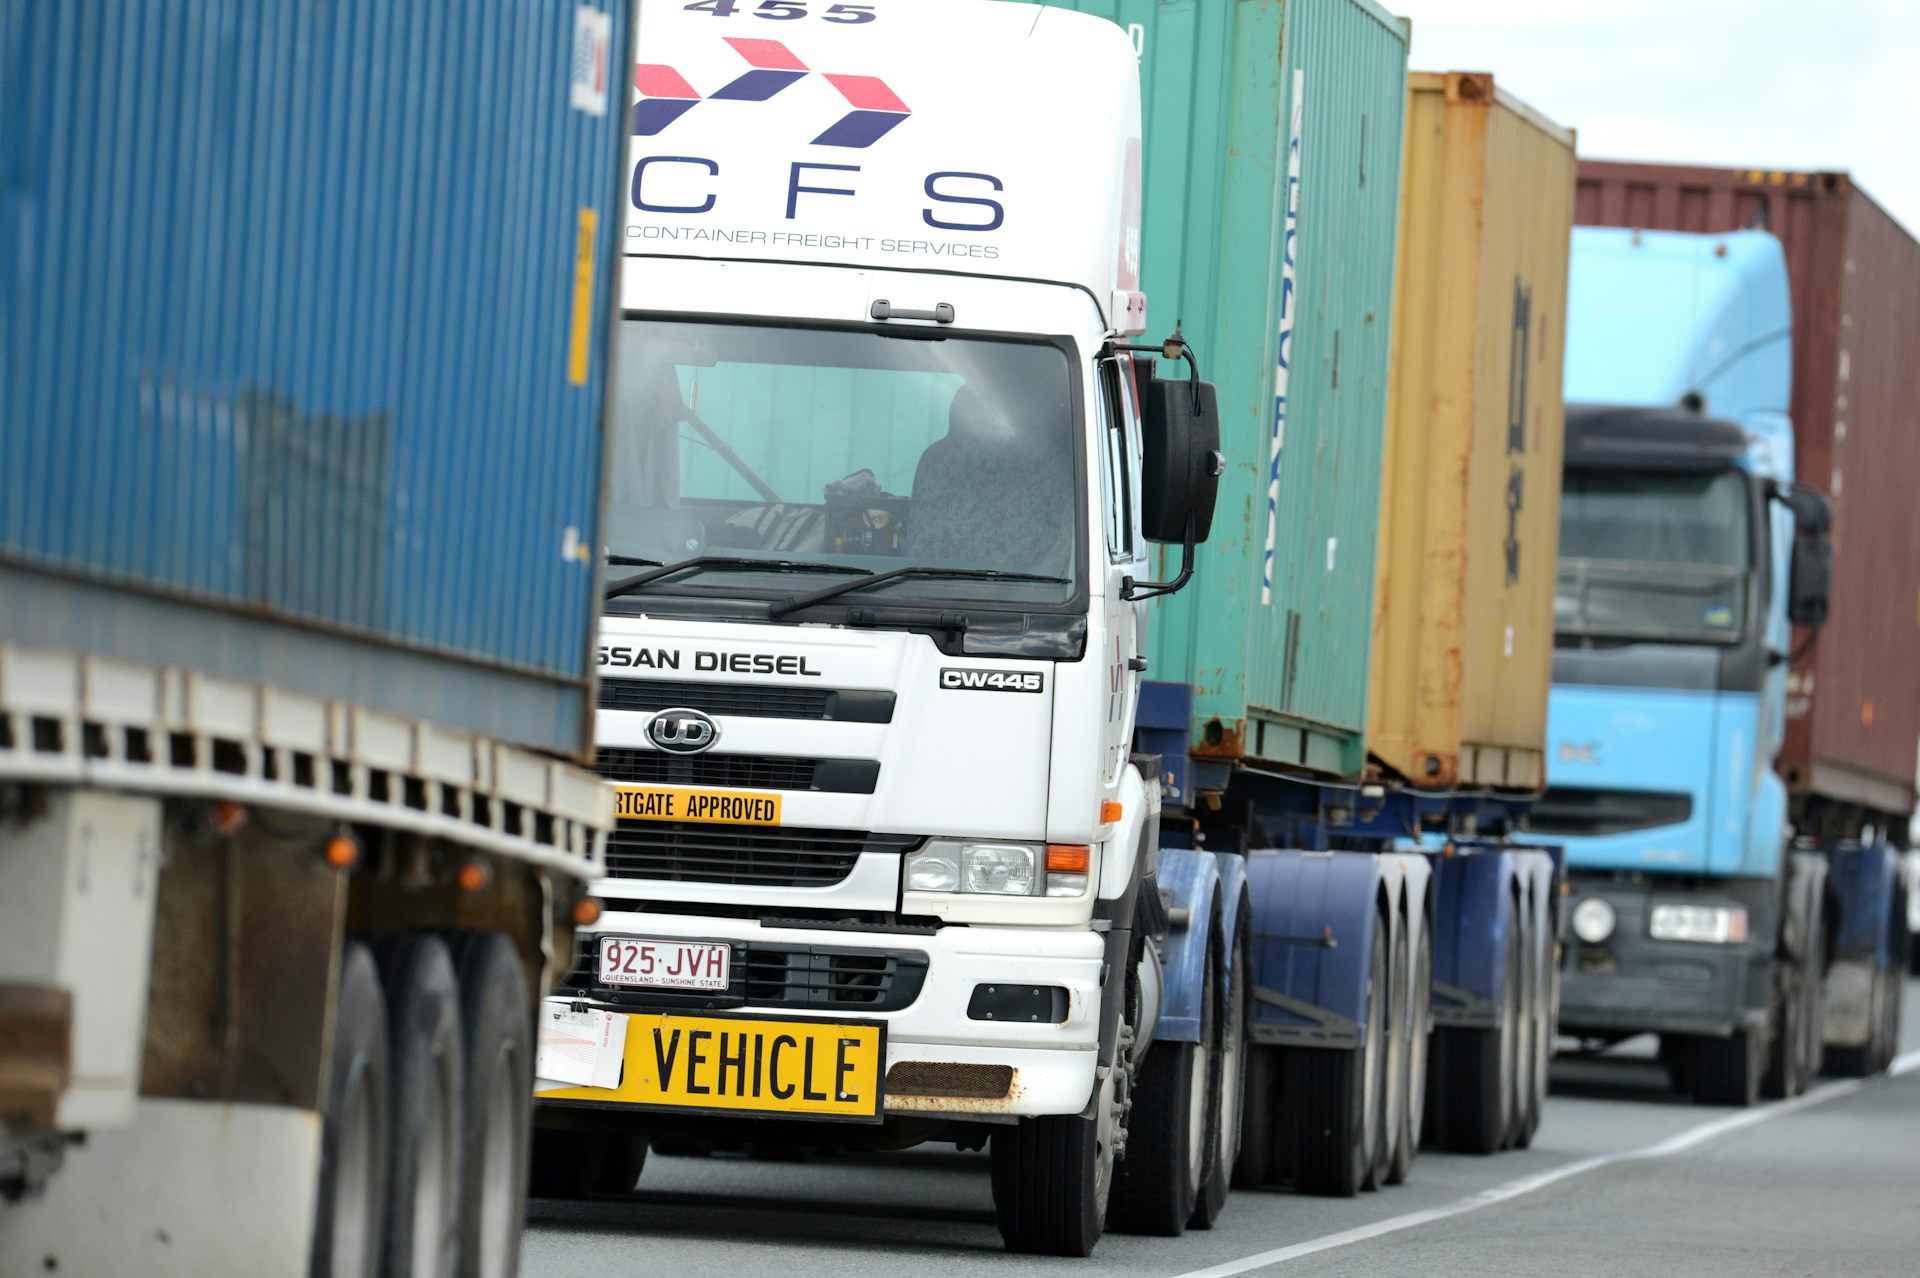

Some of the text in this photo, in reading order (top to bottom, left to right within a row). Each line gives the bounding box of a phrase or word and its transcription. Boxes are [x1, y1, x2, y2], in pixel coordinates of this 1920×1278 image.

[683, 0, 878, 24] 455
[626, 225, 1000, 259] CONTAINER FREIGHT SERVICES
[597, 646, 822, 676] SSAN DIESEL
[943, 670, 1041, 691] CW445
[654, 718, 713, 746] UD
[615, 791, 775, 822] RTGATE APPROVED
[605, 974, 722, 988] QUEENSLAND SUNSHINE STATE
[652, 1027, 860, 1103] VEHICLE
